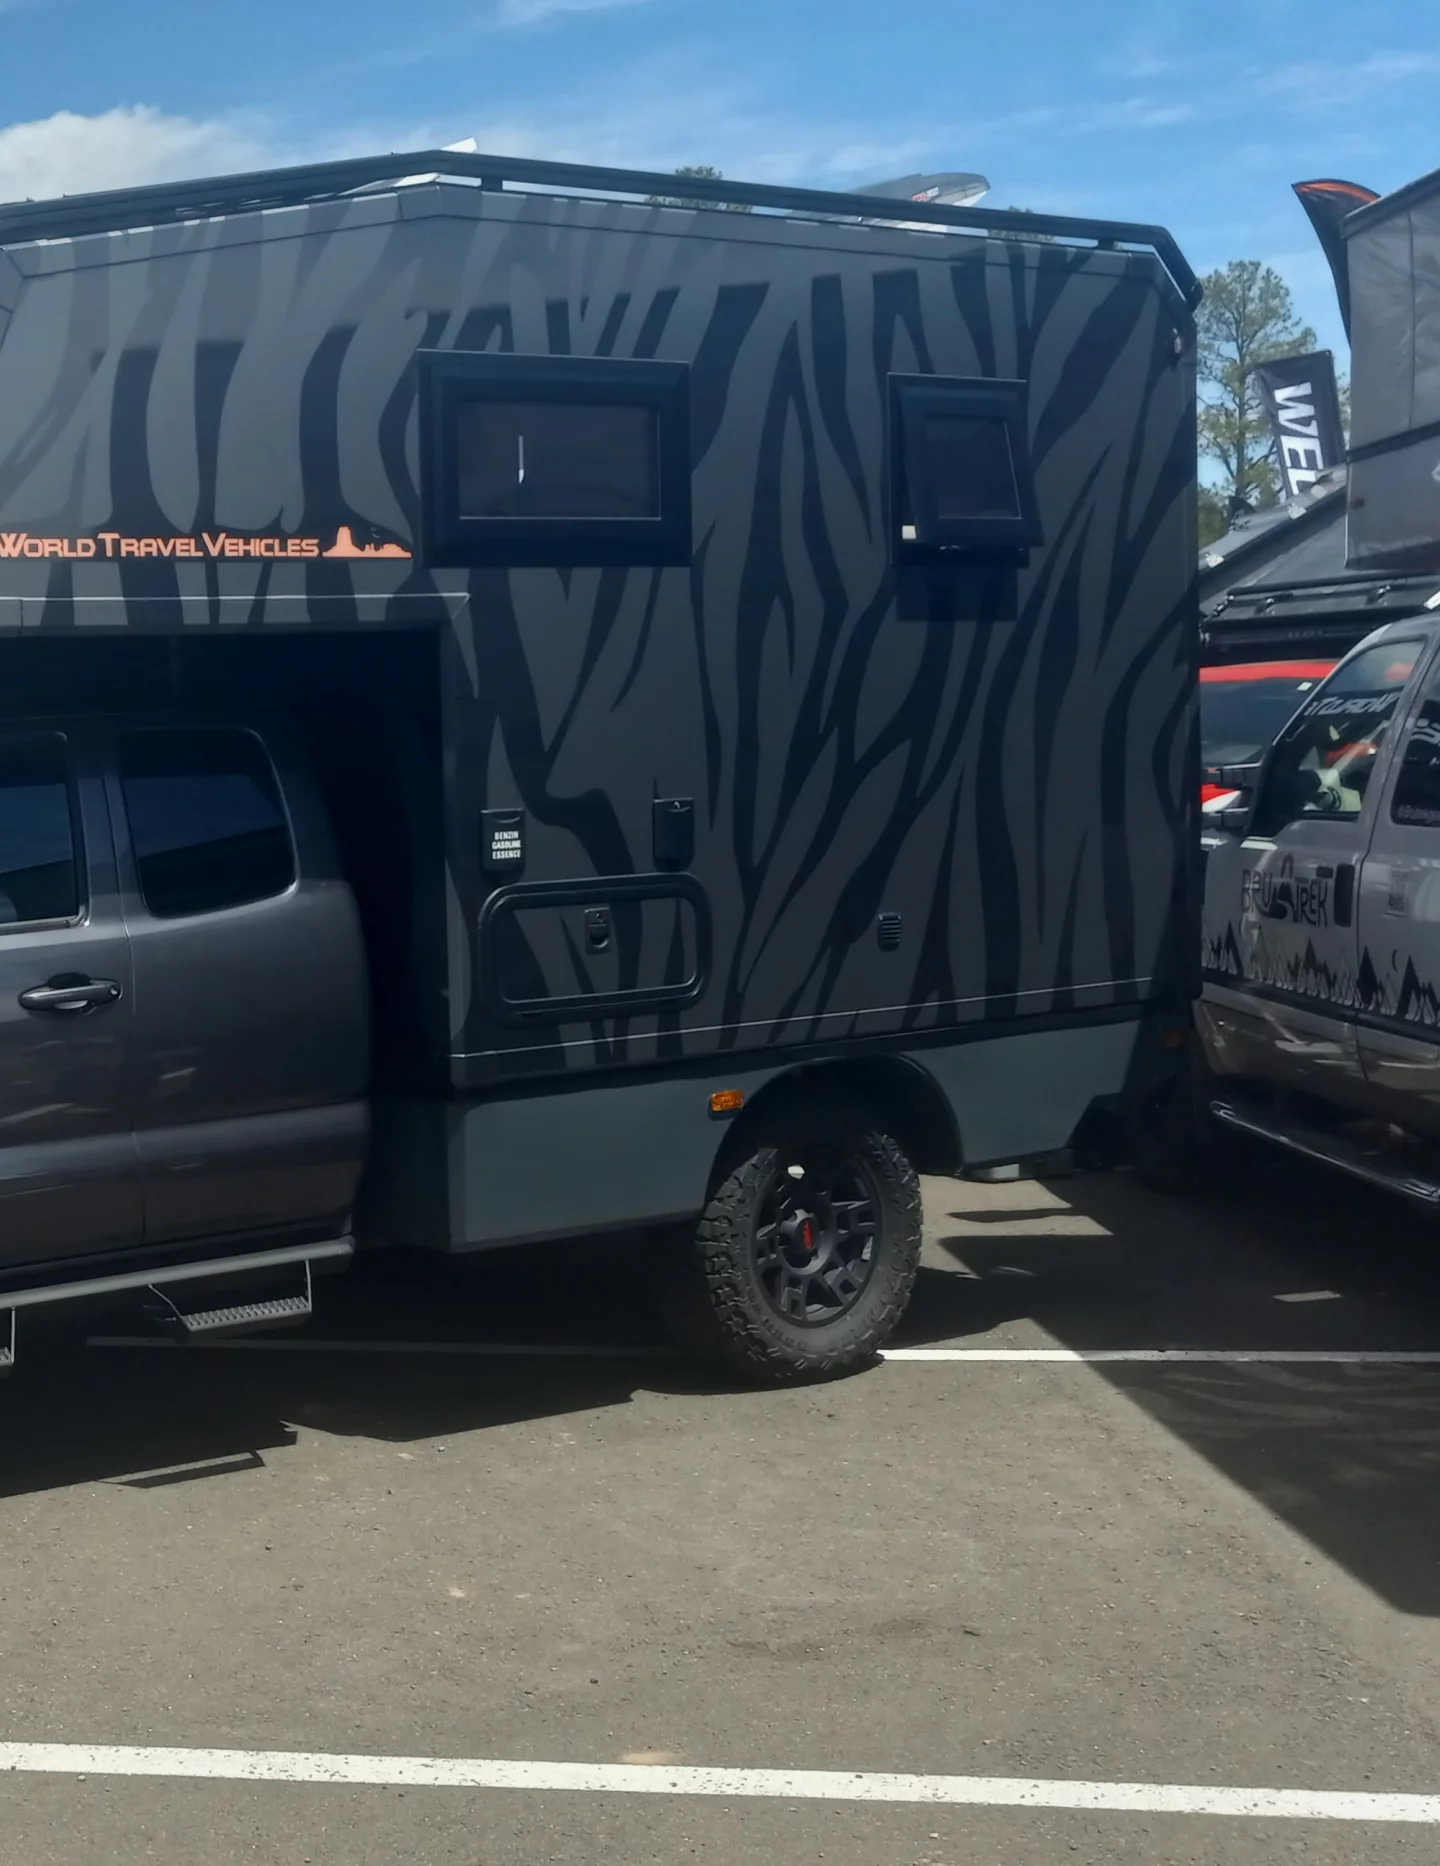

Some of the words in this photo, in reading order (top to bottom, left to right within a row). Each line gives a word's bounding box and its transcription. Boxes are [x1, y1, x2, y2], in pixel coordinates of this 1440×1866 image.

[97, 533, 203, 558] TRAVEL
[202, 532, 320, 558] VEHICLES
[494, 831, 519, 840] BENZIN
[492, 840, 521, 850] GASOLINE
[492, 849, 521, 859] ESSENCE
